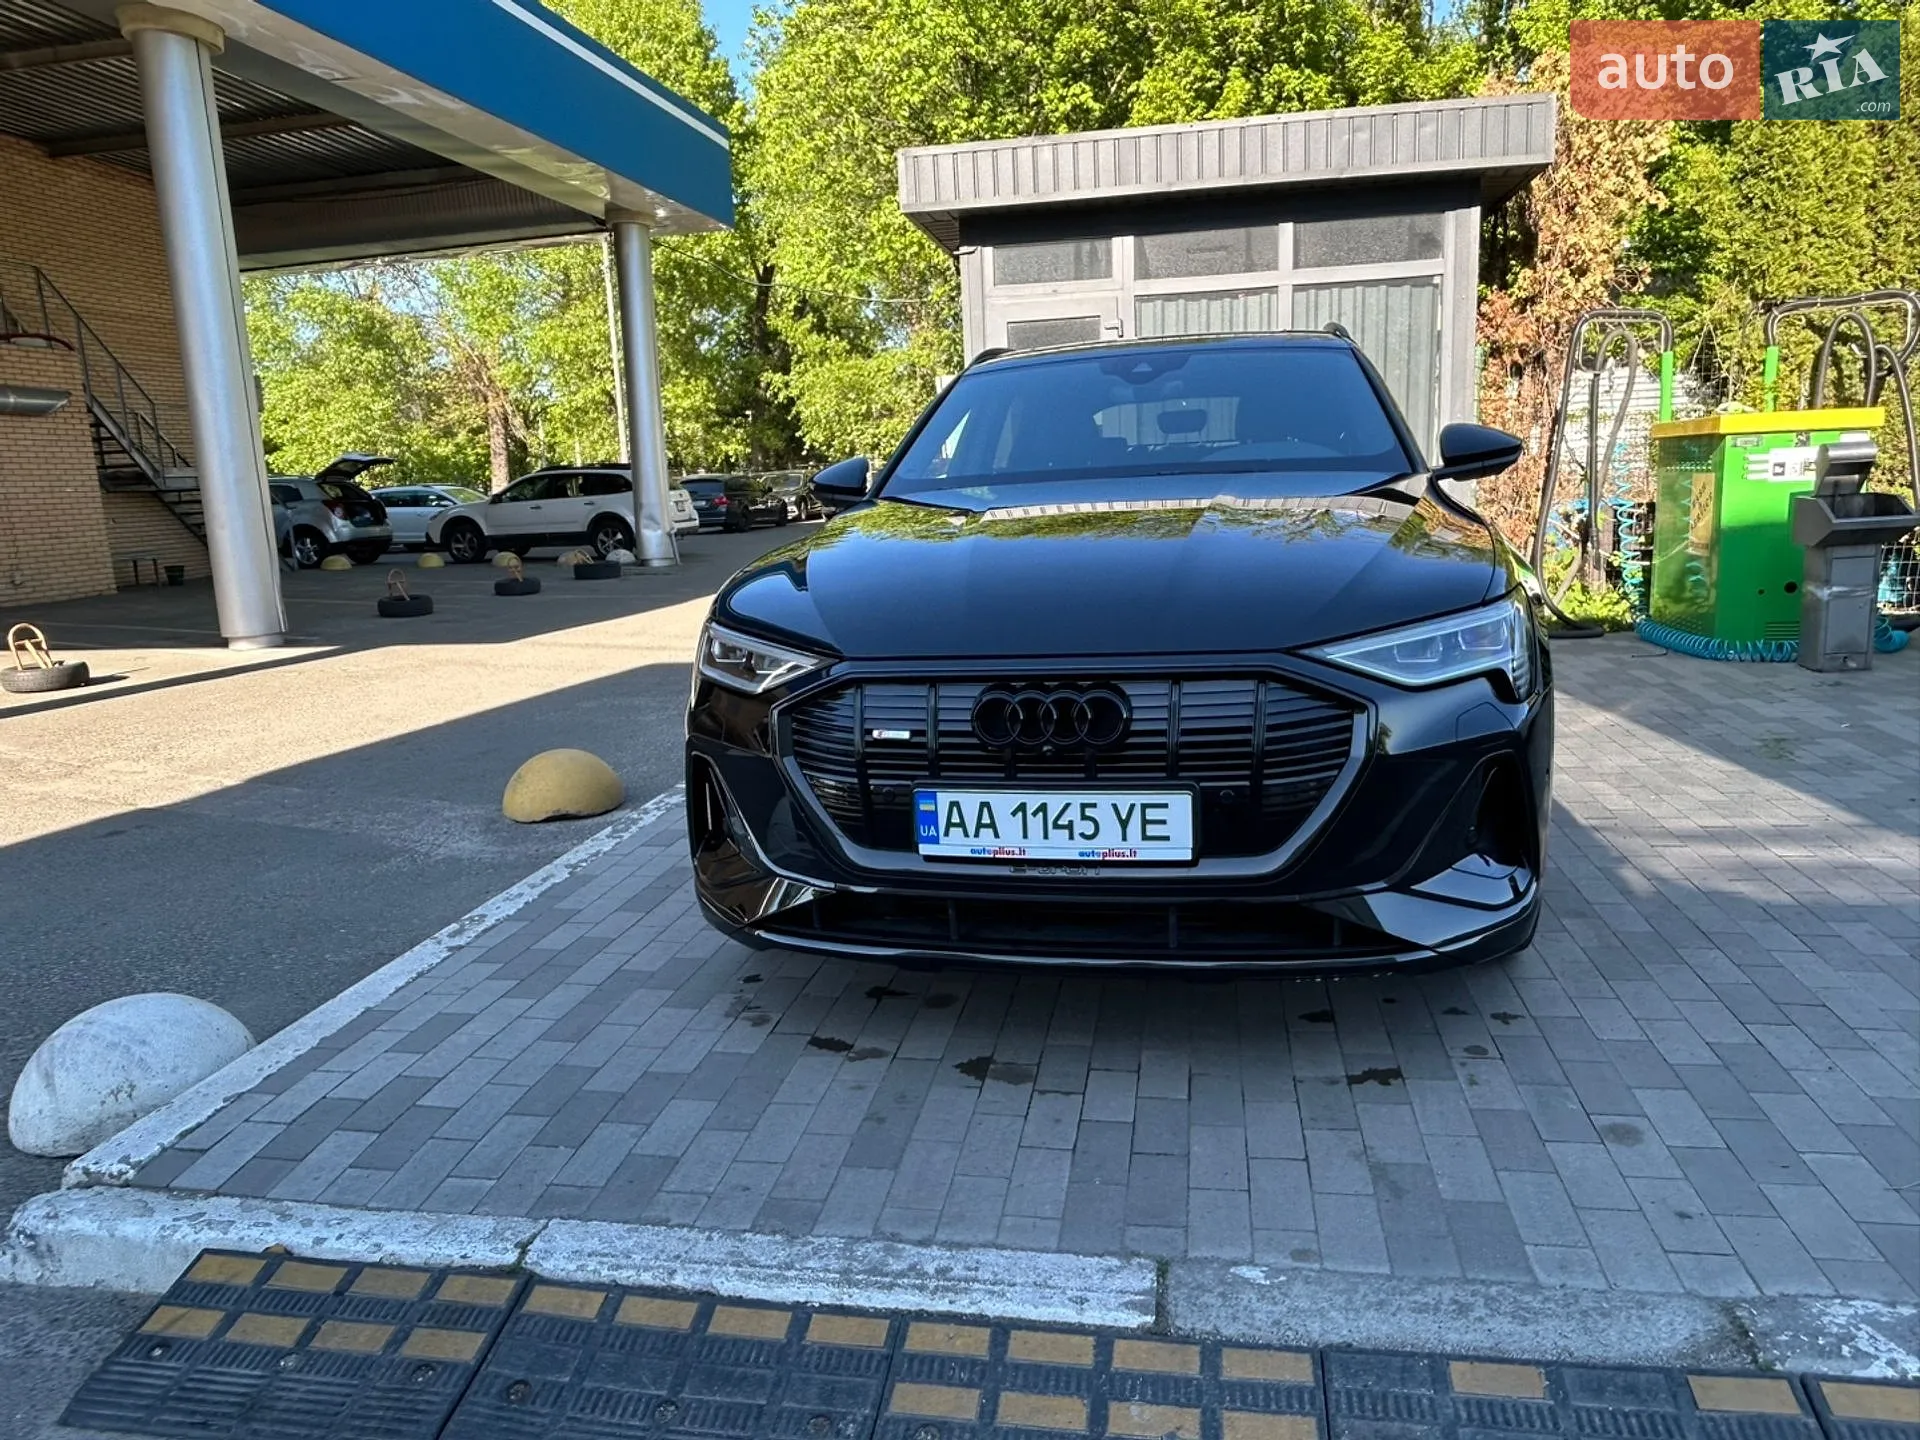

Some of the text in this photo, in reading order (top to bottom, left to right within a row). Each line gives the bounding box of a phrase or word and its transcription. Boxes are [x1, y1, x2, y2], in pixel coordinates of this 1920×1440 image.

[943, 800, 1170, 842] AA 1145 YE
[920, 825, 937, 837] UA
[970, 846, 1026, 858] autoplius.lt
[1078, 848, 1137, 860] autoplius.lt
